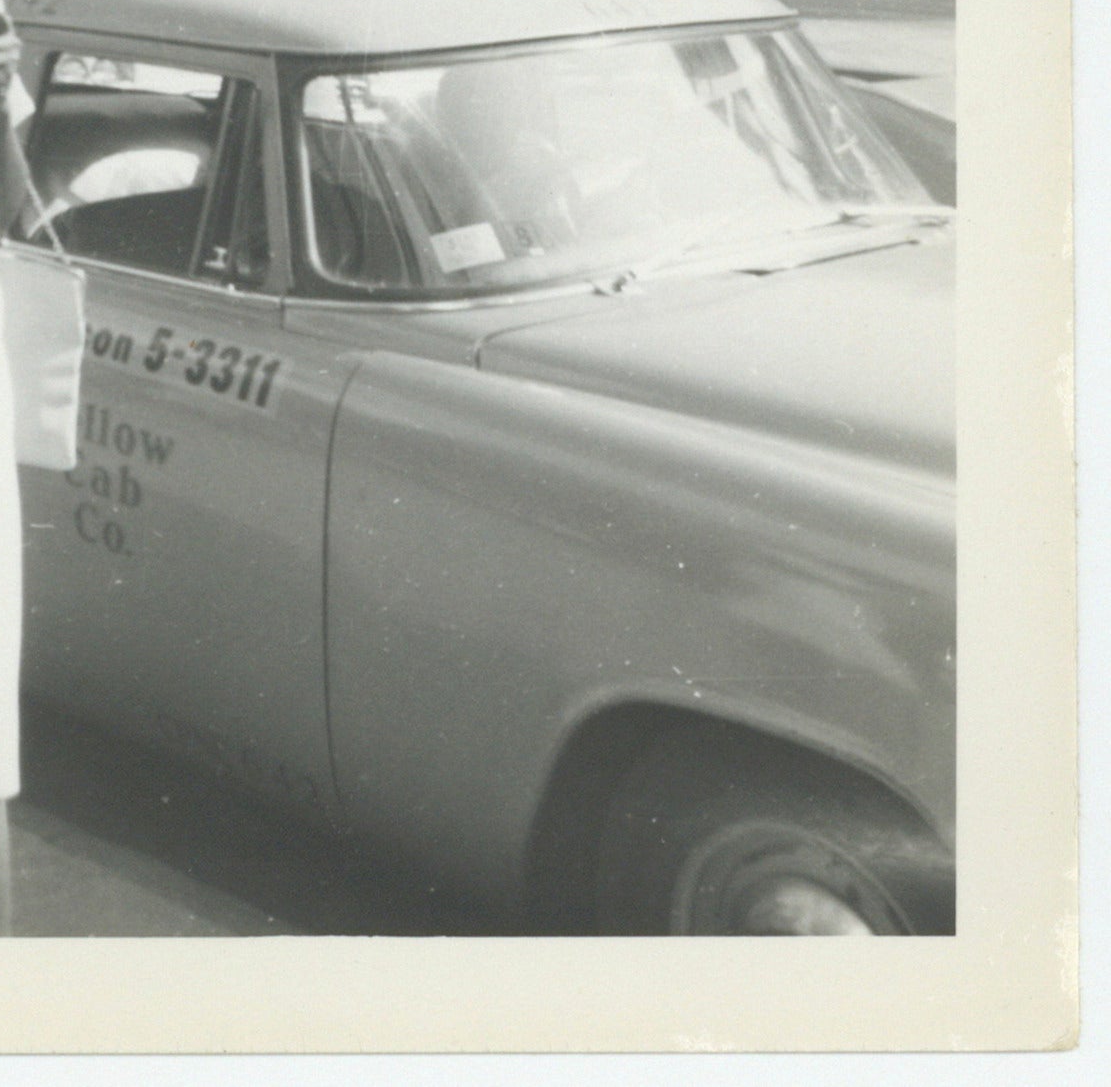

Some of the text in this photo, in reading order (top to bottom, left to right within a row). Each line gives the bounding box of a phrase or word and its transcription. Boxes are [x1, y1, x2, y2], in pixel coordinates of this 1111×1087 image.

[86, 324, 282, 408] on 5-3311
[83, 404, 175, 465] llow
